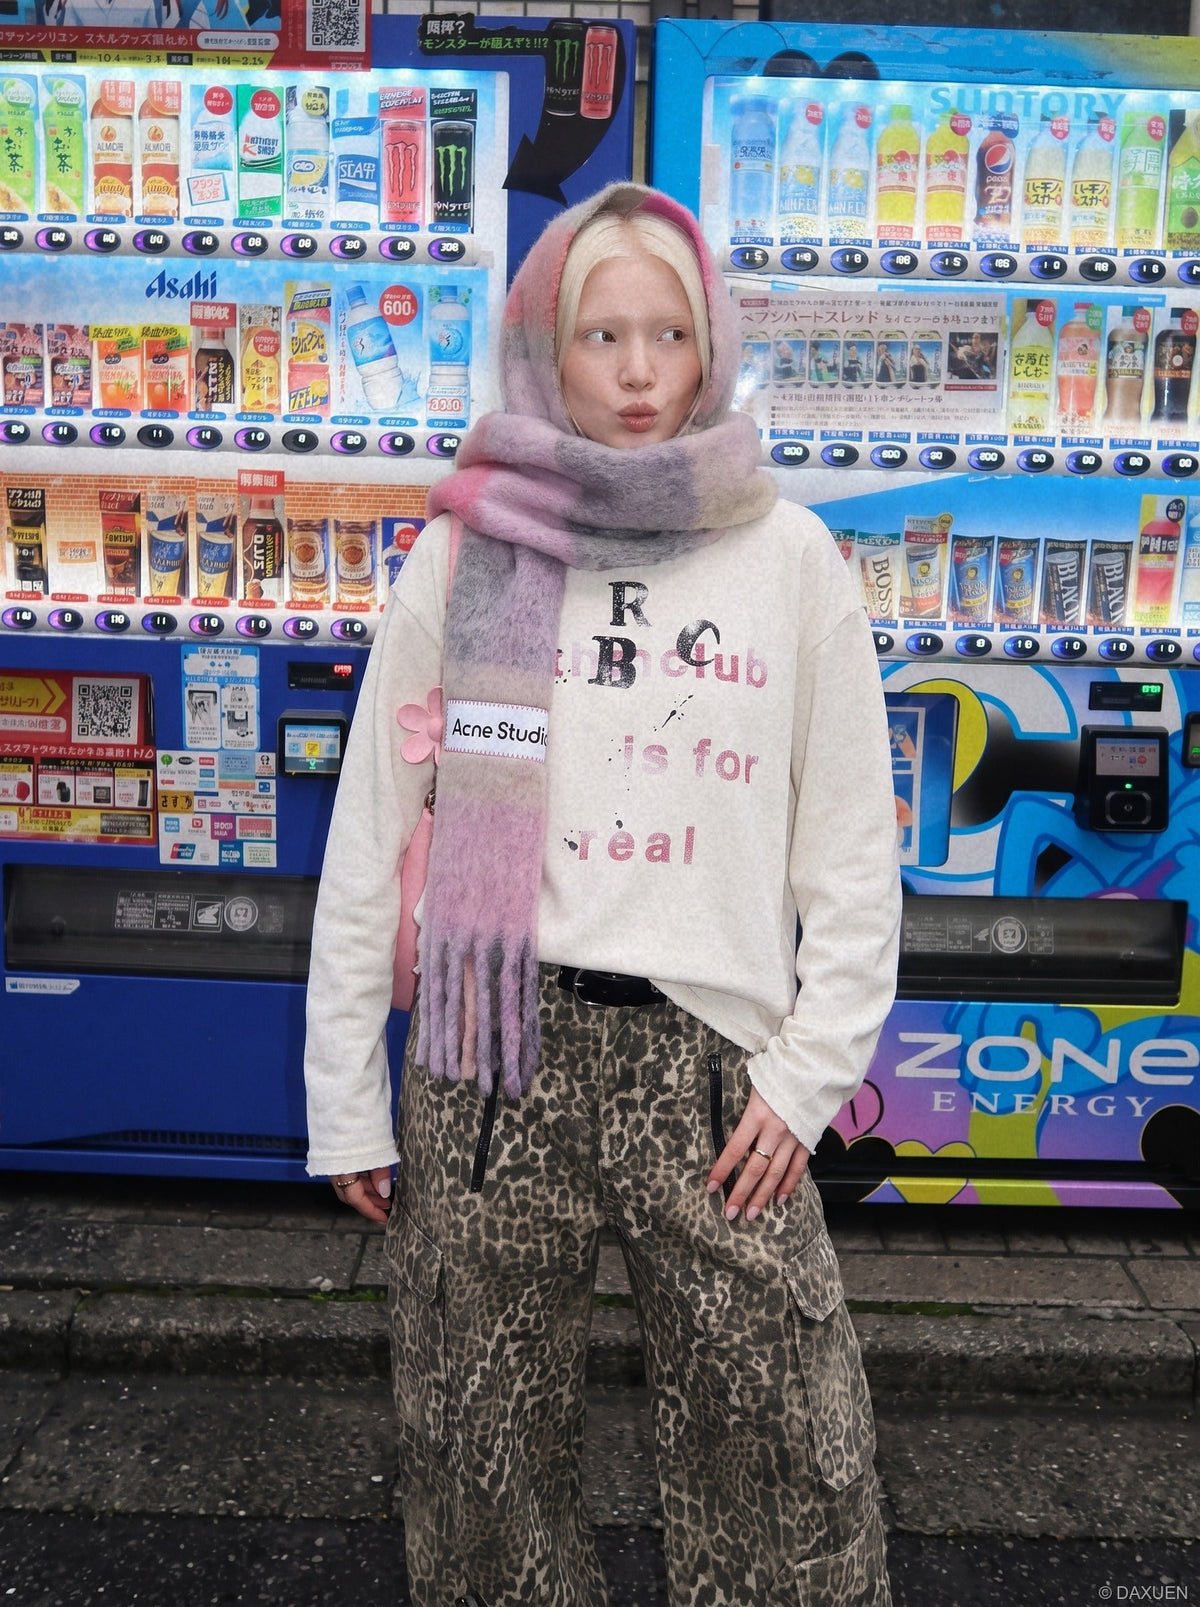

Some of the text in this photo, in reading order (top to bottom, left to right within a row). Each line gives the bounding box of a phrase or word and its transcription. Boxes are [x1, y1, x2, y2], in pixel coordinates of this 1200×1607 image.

[145, 269, 217, 300] Asahi
[383, 301, 412, 316] 600
[608, 581, 652, 627] R
[870, 556, 893, 615] BOSS
[587, 635, 637, 690] B
[452, 718, 493, 739] Acne
[623, 735, 760, 784] is for
[578, 825, 696, 865] real
[931, 1090, 1155, 1118] ENERGY
